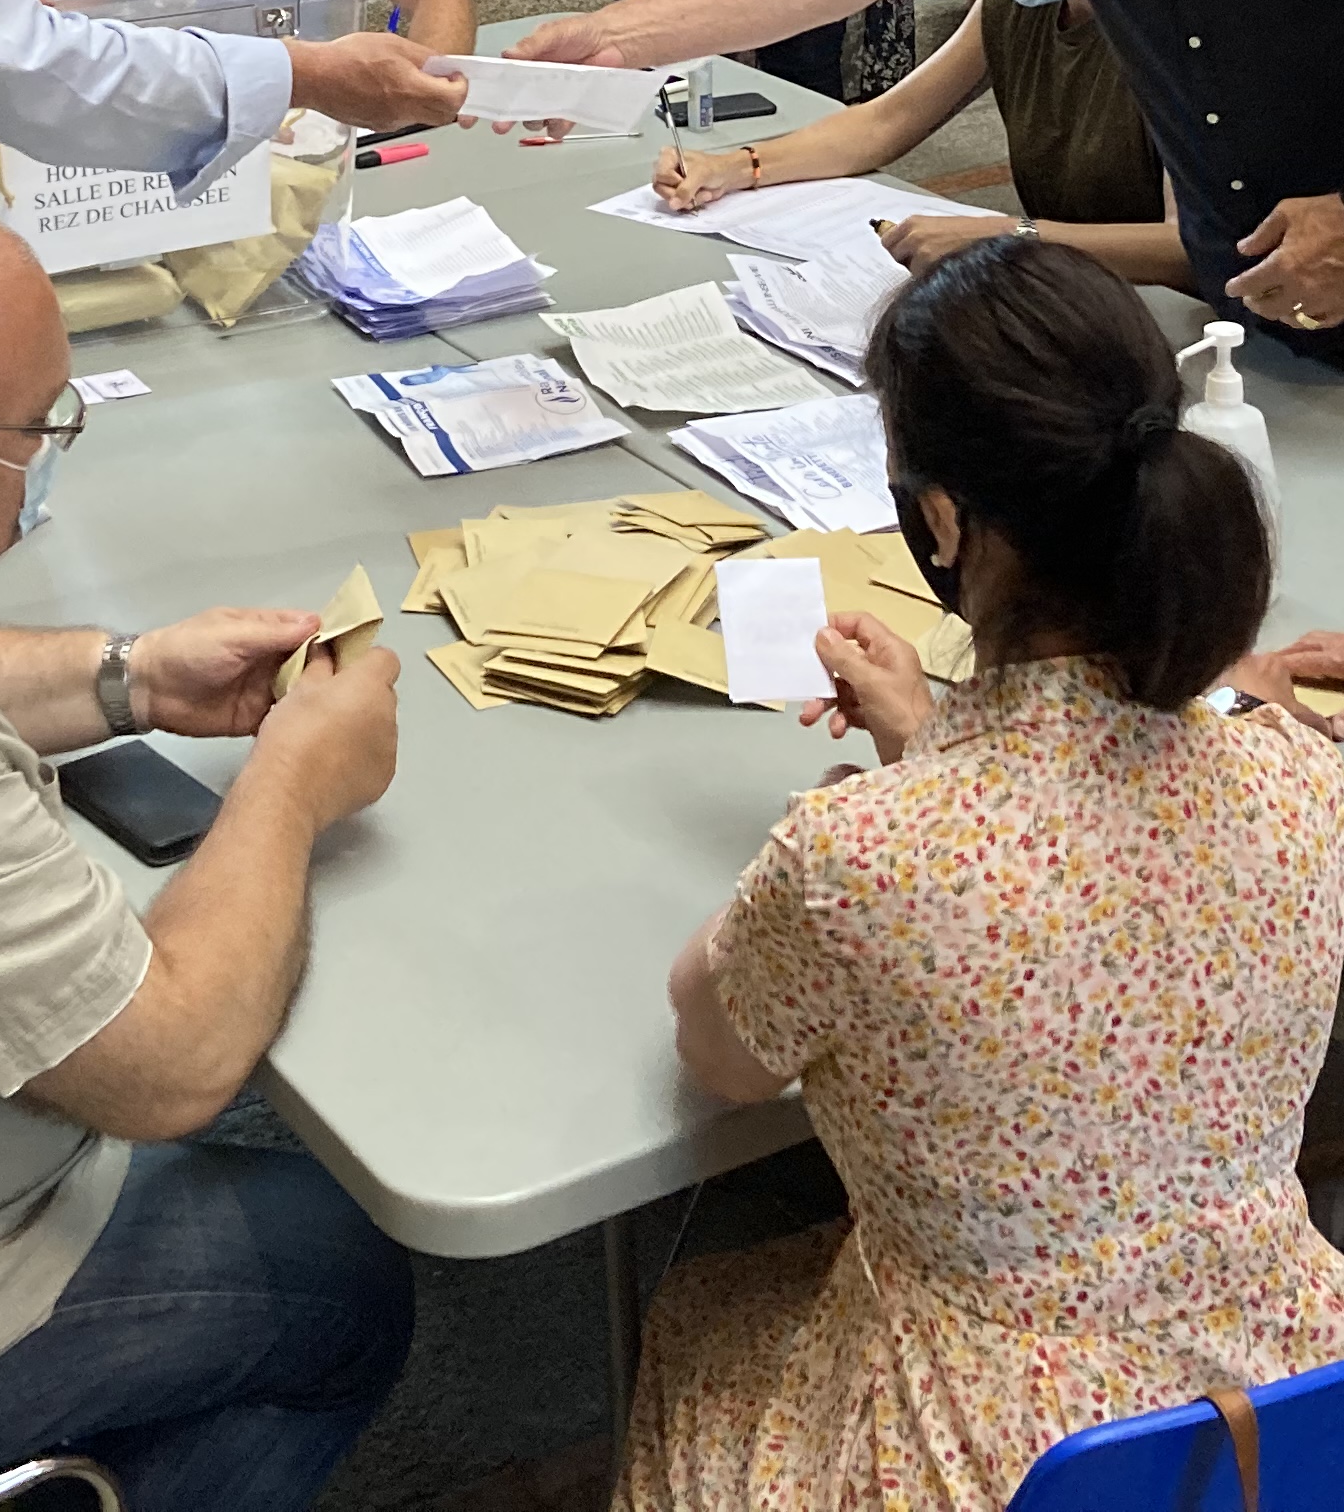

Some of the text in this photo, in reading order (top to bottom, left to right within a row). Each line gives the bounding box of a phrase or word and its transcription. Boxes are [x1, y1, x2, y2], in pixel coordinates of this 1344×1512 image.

[34, 184, 103, 210] SALLE
[108, 178, 136, 197] DE
[39, 187, 231, 233] REZ DE CHAUSEE
[807, 454, 853, 488] BENEDETT
